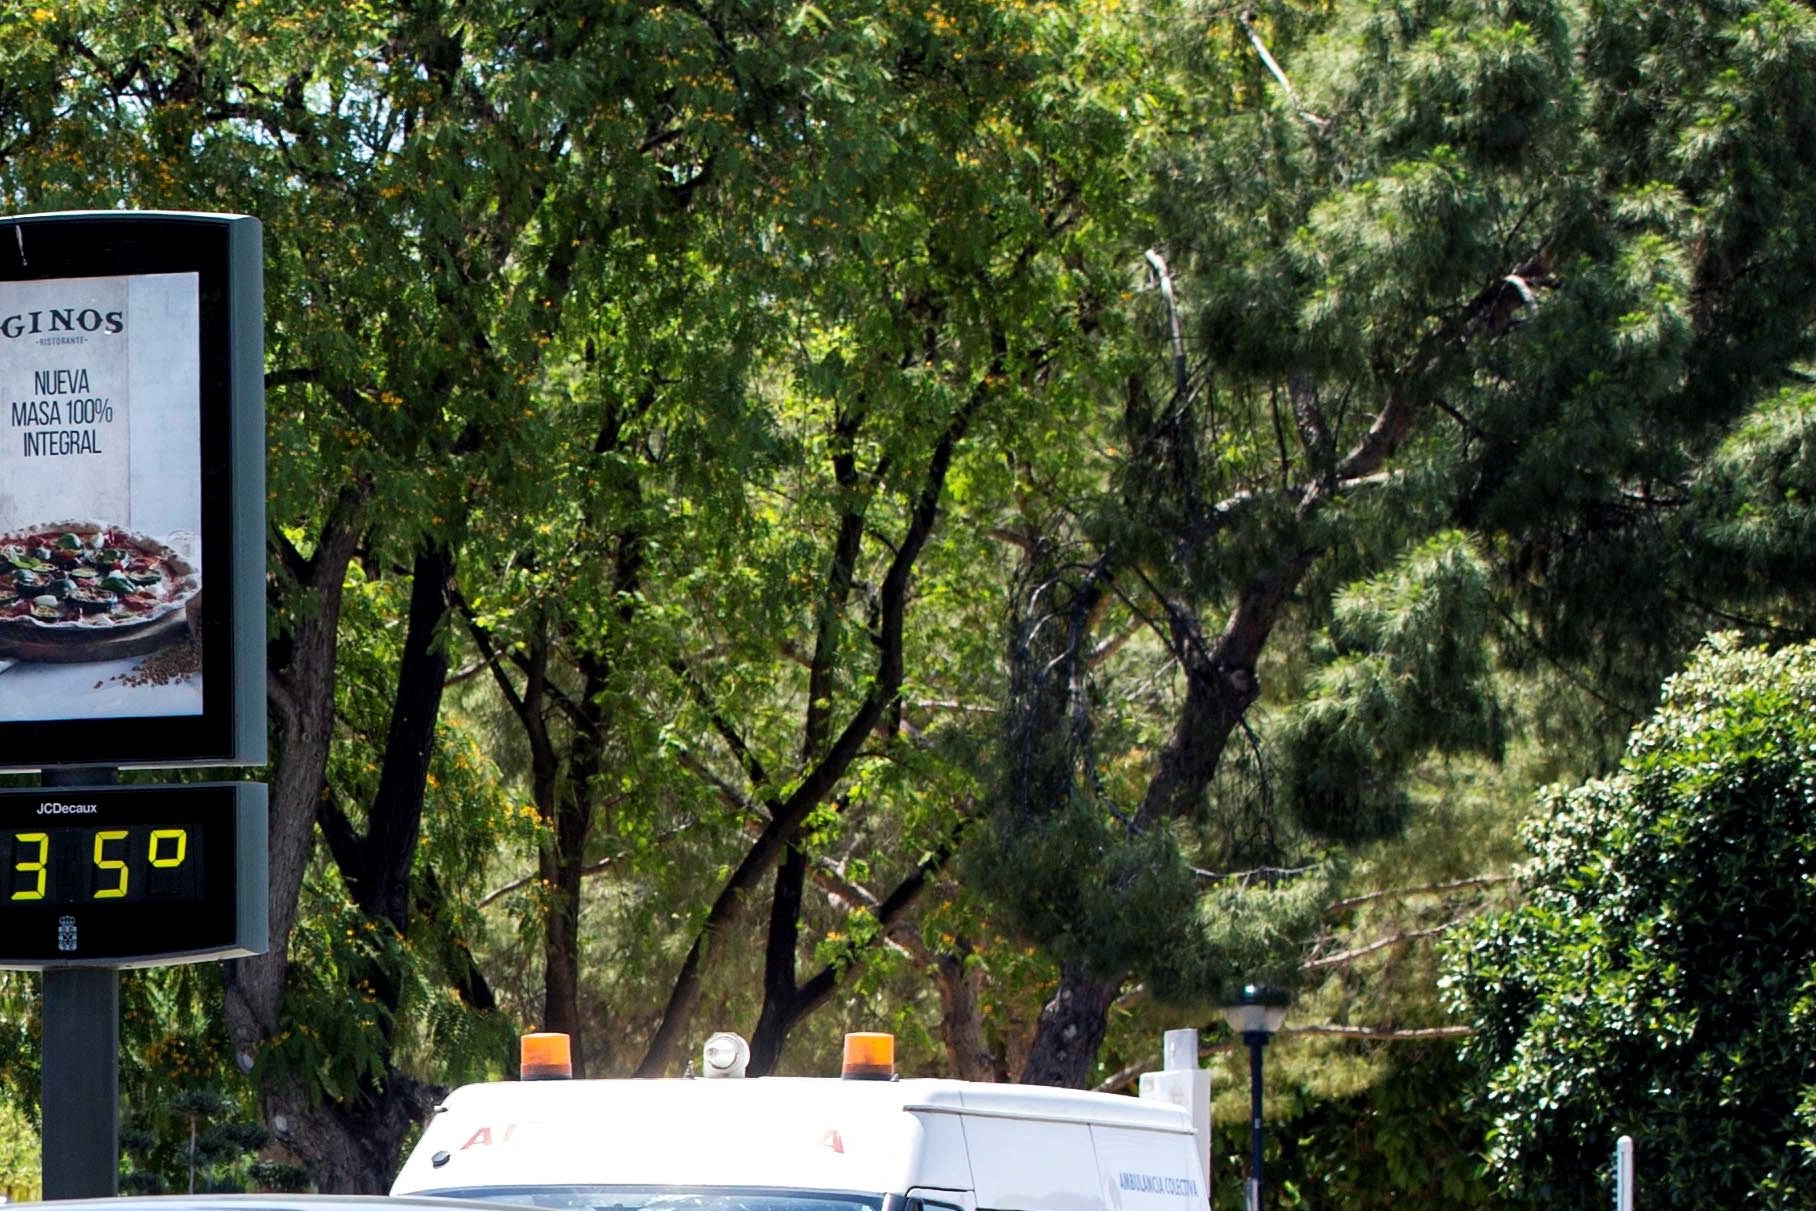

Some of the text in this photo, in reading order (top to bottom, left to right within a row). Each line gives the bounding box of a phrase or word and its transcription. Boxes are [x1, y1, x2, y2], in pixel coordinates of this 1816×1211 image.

[0, 308, 124, 338] GINOS
[35, 369, 90, 395] NUEVA
[11, 398, 113, 427] MASA 100%
[24, 429, 102, 457] INTEGRAL
[36, 802, 98, 815] JCDecaux
